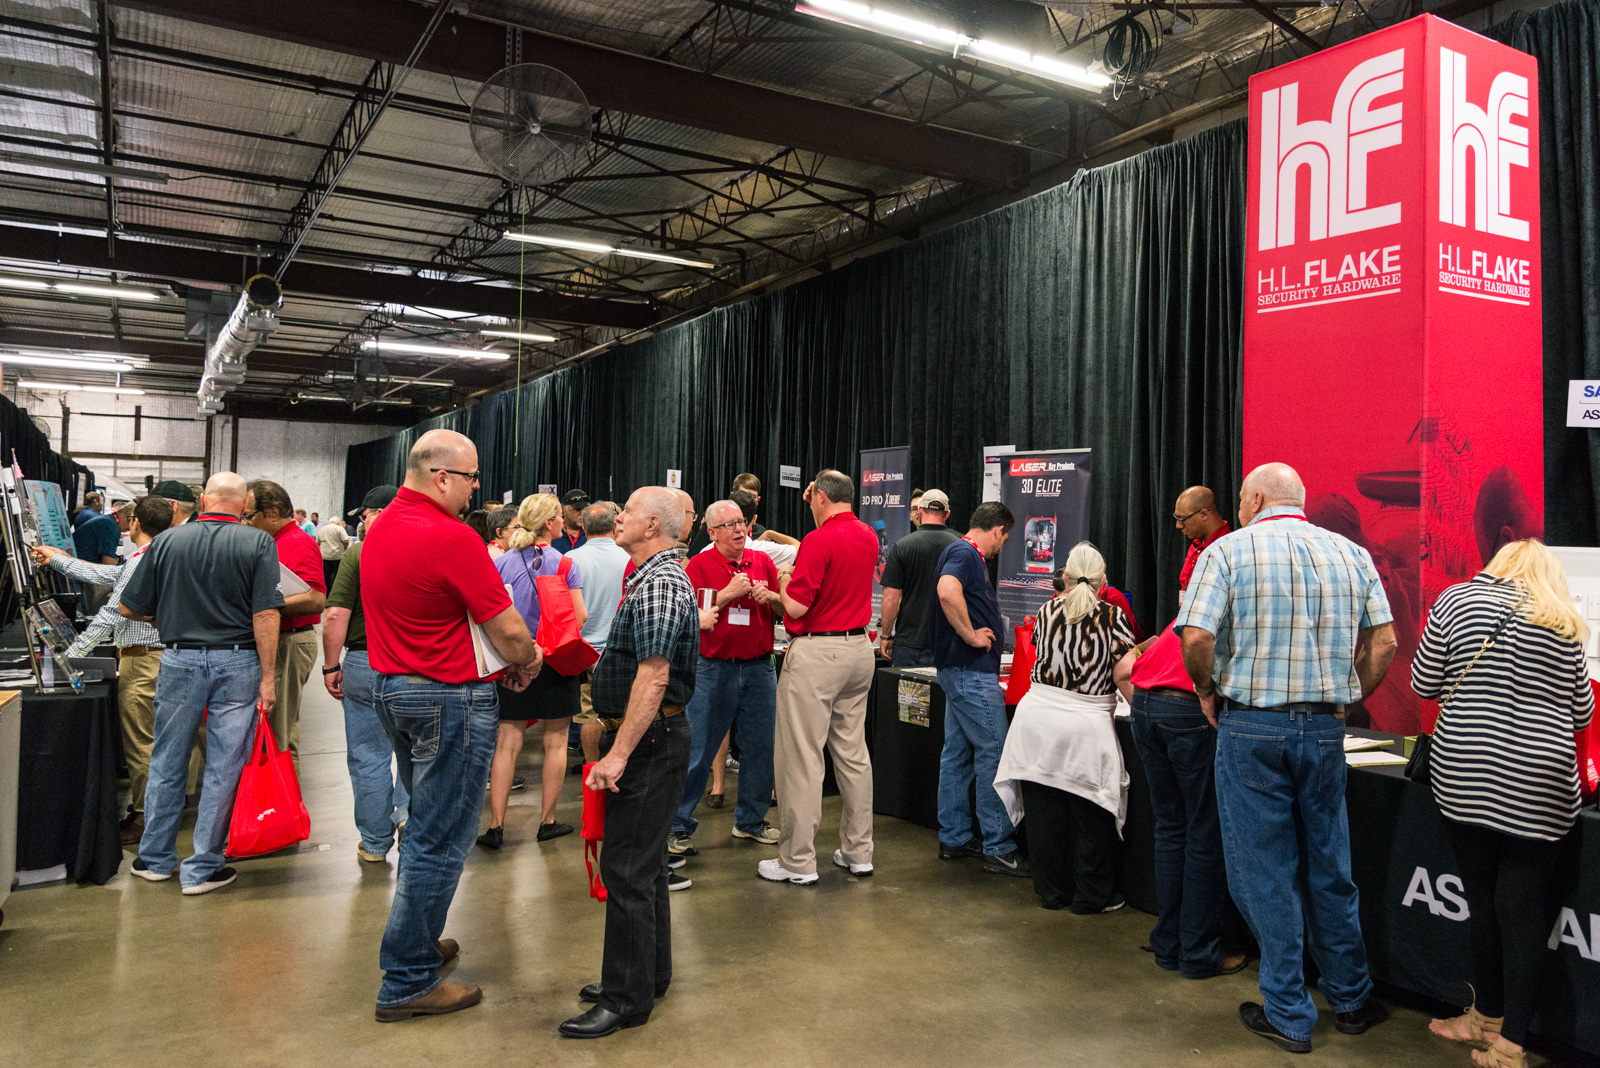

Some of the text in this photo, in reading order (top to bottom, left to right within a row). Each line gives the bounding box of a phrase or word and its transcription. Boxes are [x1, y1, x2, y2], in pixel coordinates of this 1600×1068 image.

[1258, 272, 1402, 306] SECURITY HARDWARE
[1439, 271, 1530, 298] SECURITY HARDWARE
[1011, 462, 1047, 473] LASER
[863, 472, 885, 482] LASER
[1021, 478, 1063, 494] 3D ELITE
[861, 495, 870, 506] 3D
[871, 495, 883, 505] PRO
